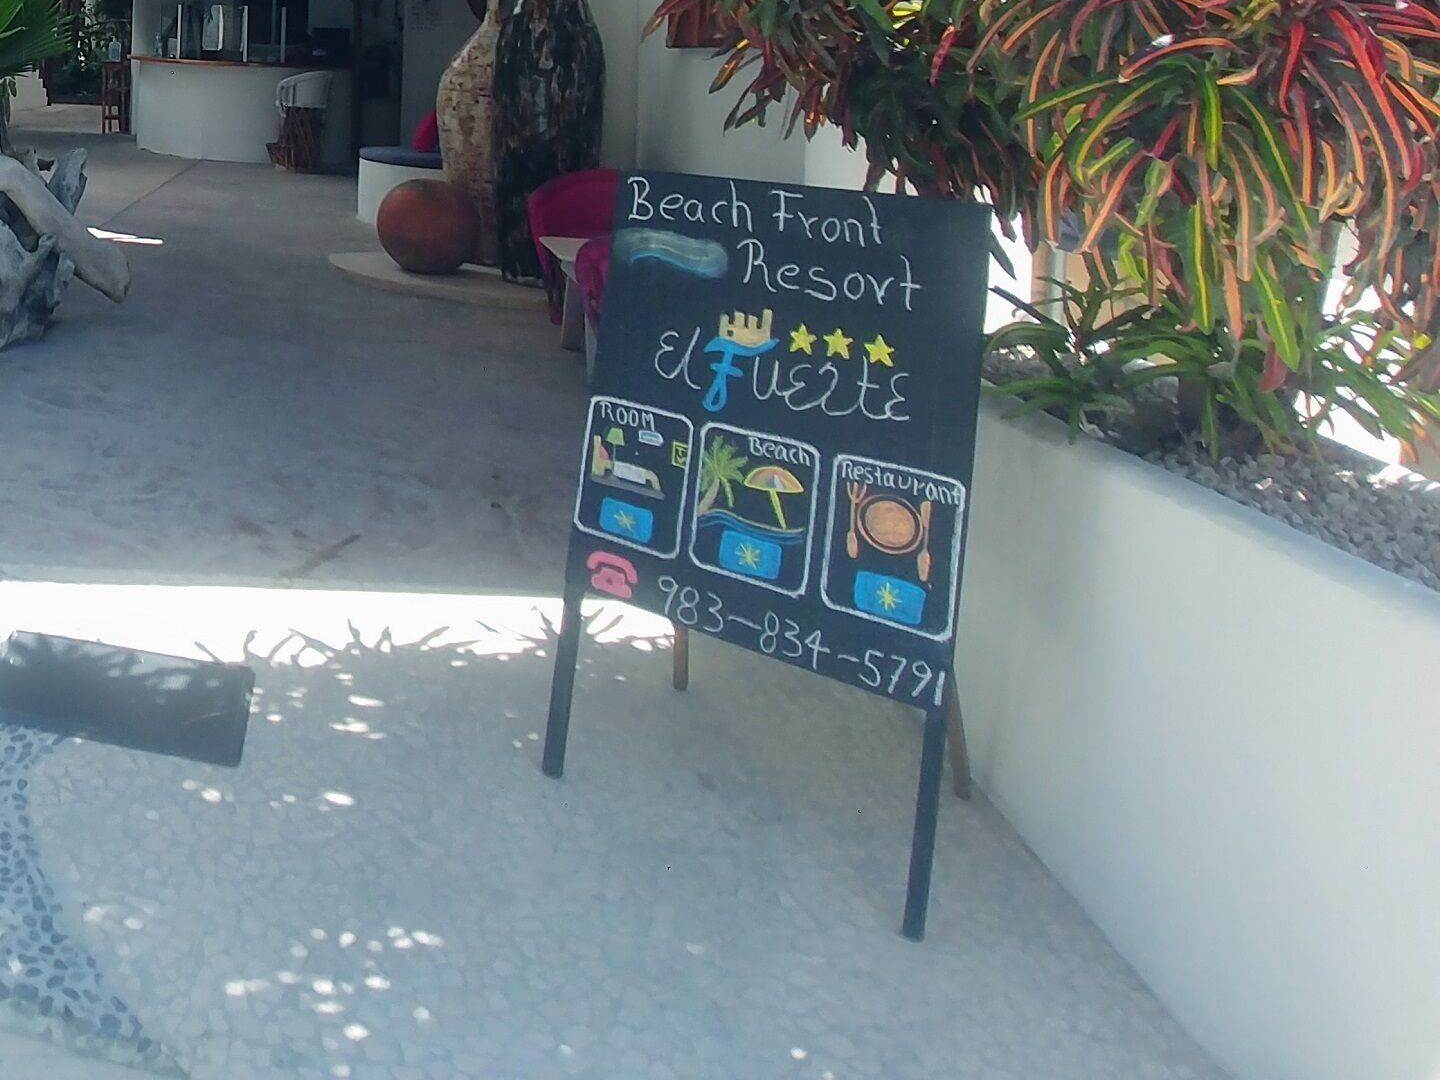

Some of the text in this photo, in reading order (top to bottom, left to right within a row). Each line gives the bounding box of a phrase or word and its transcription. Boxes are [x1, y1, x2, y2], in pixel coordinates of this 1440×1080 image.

[627, 176, 883, 247] Beach Front
[736, 239, 922, 311] Resort
[654, 326, 702, 390] El
[747, 436, 811, 467] Beach
[841, 460, 961, 505] Restaurant
[657, 575, 946, 707] 983-834-5791
